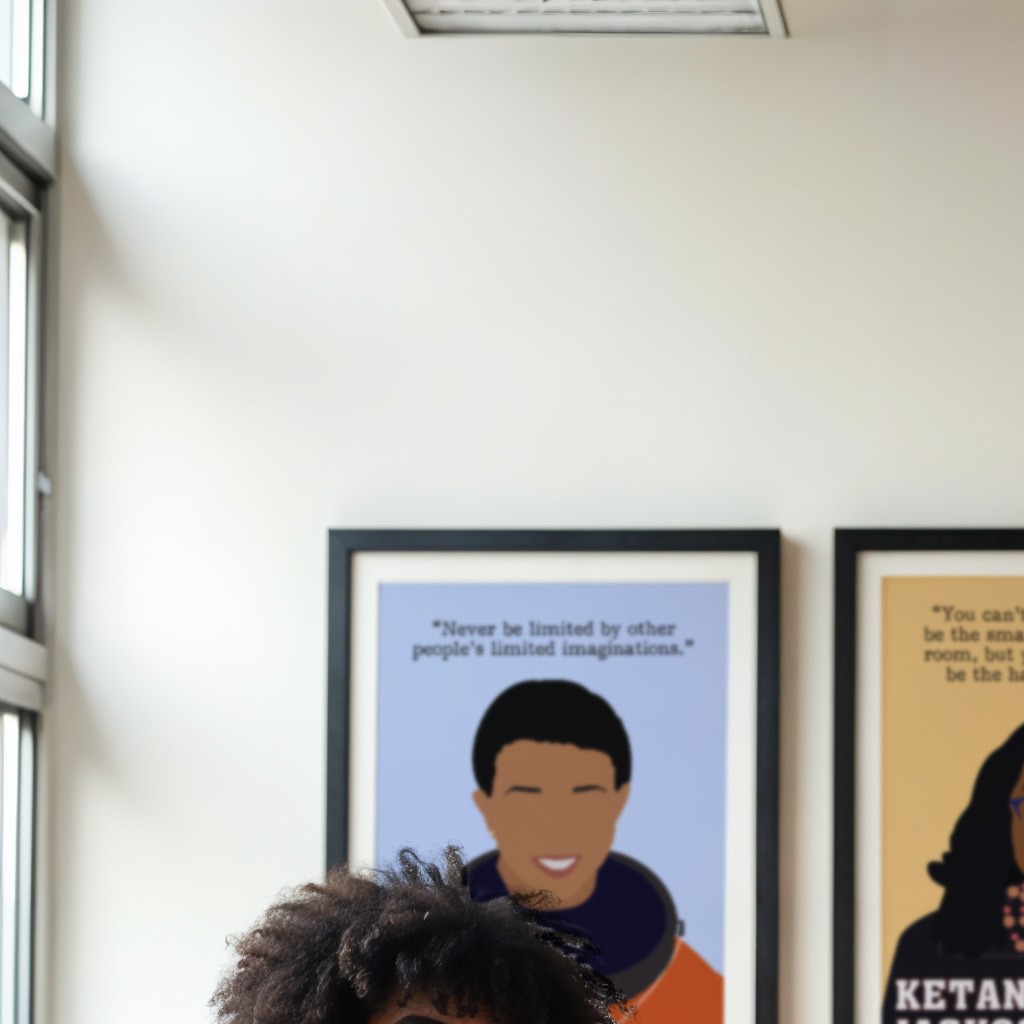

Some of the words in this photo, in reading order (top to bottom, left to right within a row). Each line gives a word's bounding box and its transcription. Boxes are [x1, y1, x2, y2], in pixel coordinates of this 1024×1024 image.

[503, 620, 523, 636] be
[529, 620, 594, 636] limited
[600, 620, 621, 640] by
[627, 620, 677, 636] other
[924, 627, 944, 642] be
[950, 627, 980, 642] the
[490, 640, 556, 656] limited
[923, 650, 978, 664] room,
[984, 647, 1014, 662] but
[946, 667, 966, 682] be
[973, 667, 1002, 682] the
